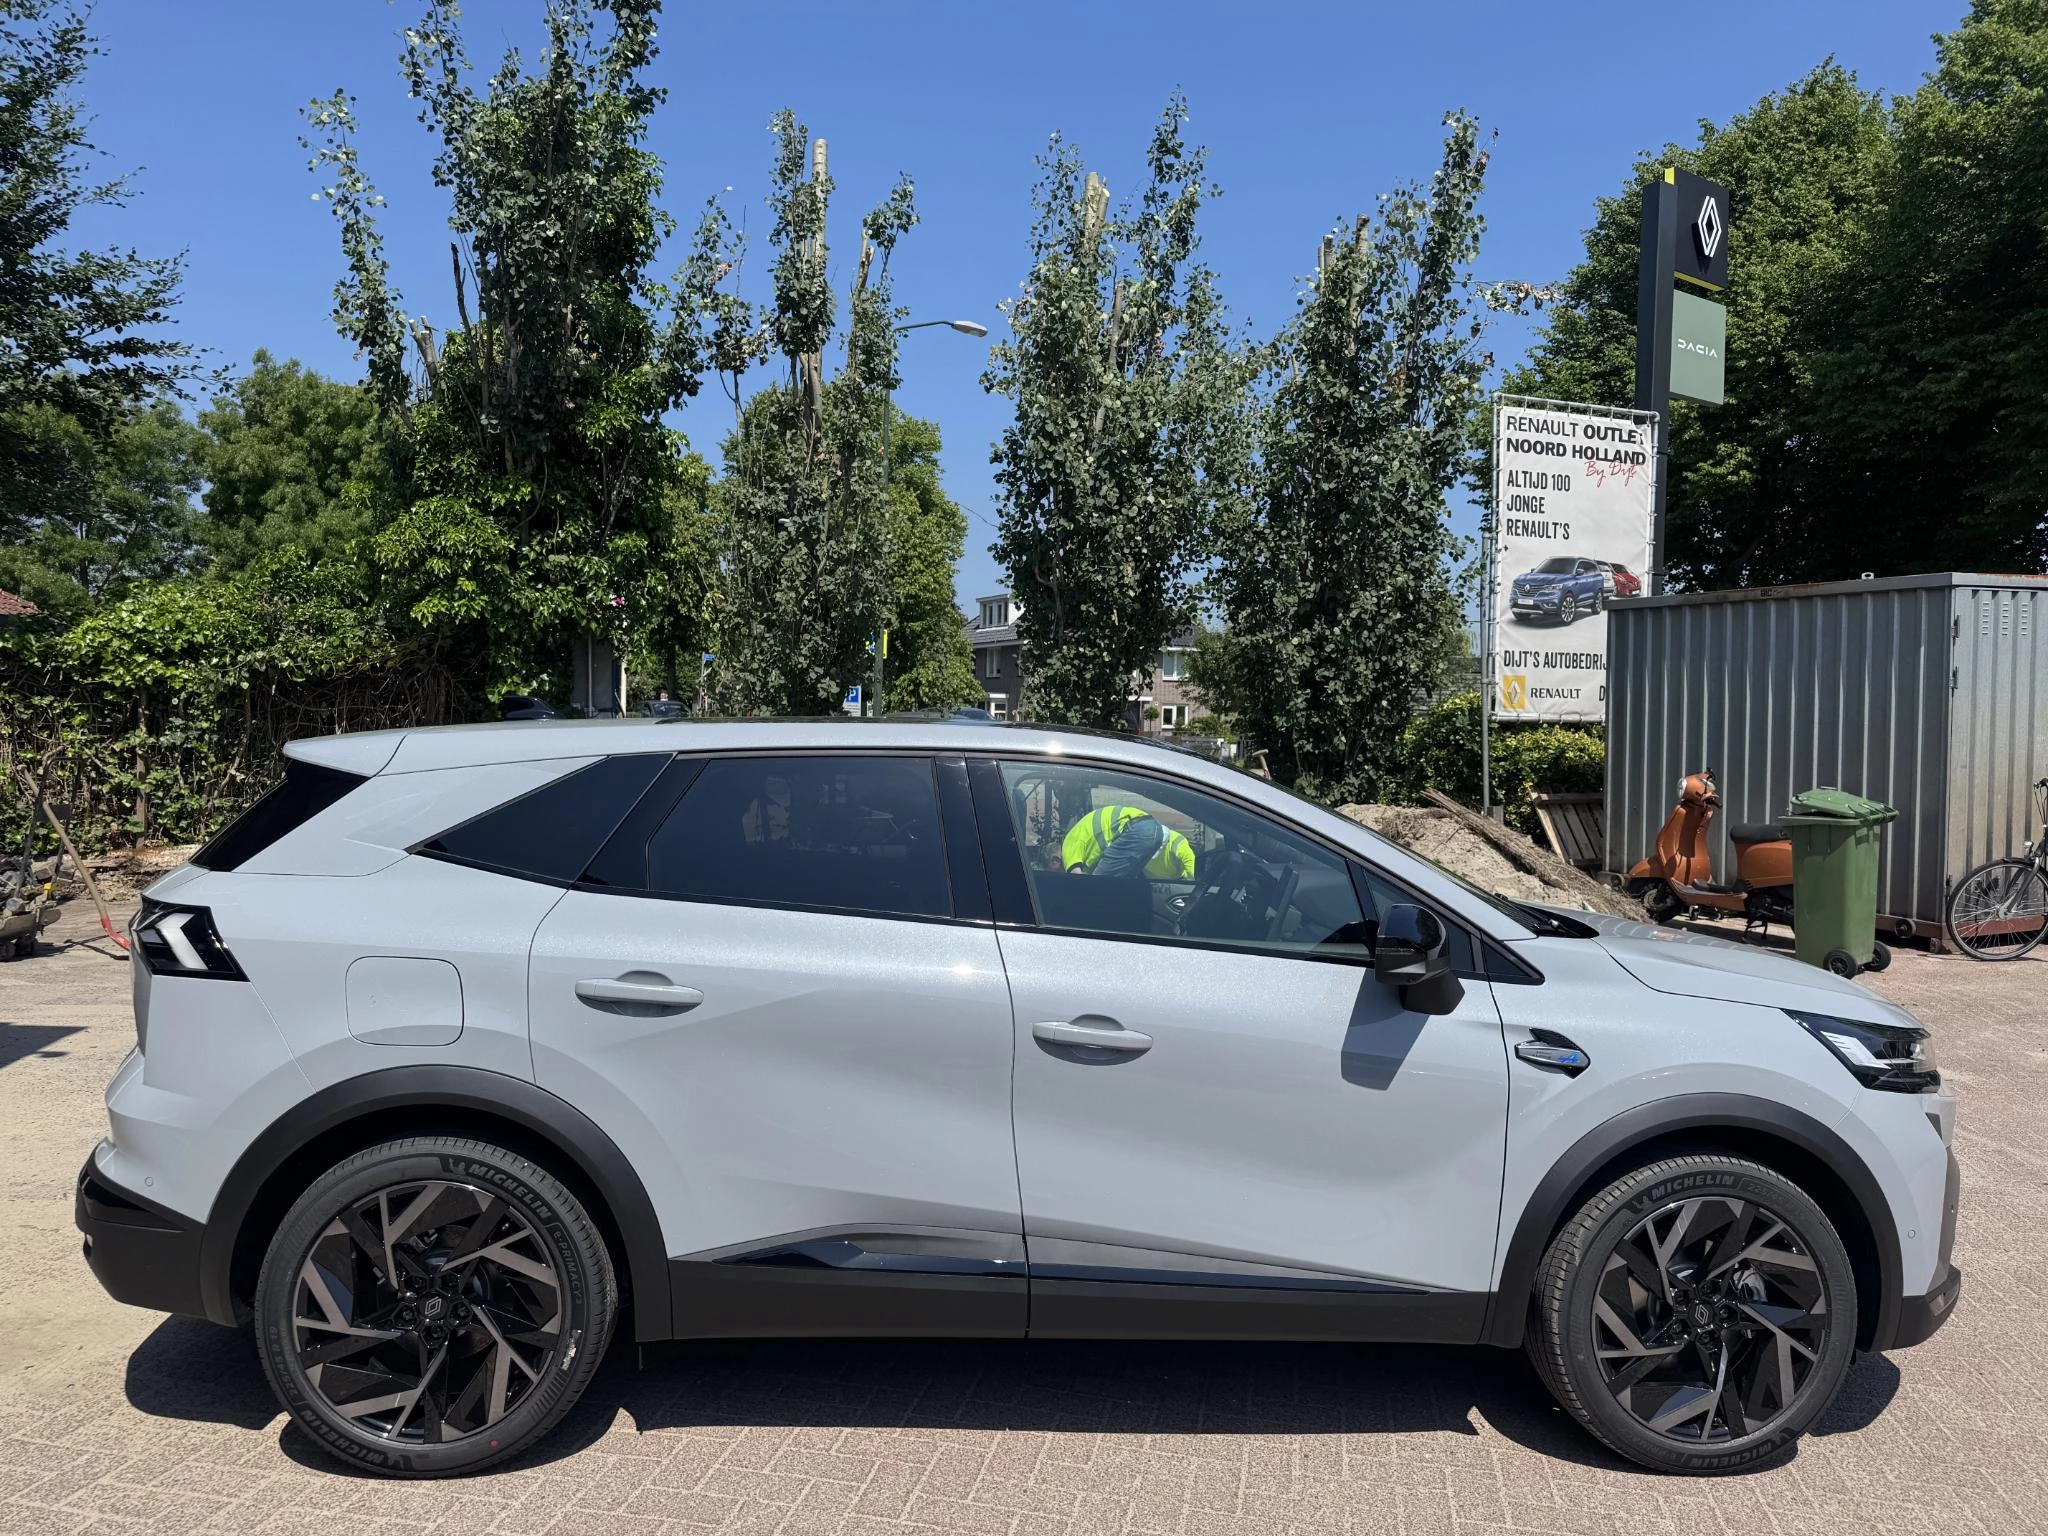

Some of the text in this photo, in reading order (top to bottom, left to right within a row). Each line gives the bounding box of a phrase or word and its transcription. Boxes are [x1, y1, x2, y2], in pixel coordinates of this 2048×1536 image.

[1678, 338, 1718, 358] DACIA
[1507, 416, 1578, 437] RENAULT
[1506, 438, 1647, 466] NOORD HOLLAND
[1507, 470, 1570, 492] ALTIJD 100
[1585, 461, 1606, 488] By
[1507, 494, 1545, 514] JONGE
[1507, 519, 1569, 540] RENAULT'S
[1504, 650, 1540, 668] DIJT'S
[848, 688, 857, 701] P
[1530, 688, 1581, 699] RENAULT
[469, 1163, 553, 1220] MICHELIN
[1651, 1174, 1734, 1200] MICHELIN
[299, 1408, 385, 1465] MICHELIN
[1690, 1441, 1772, 1468] MICHELIN
